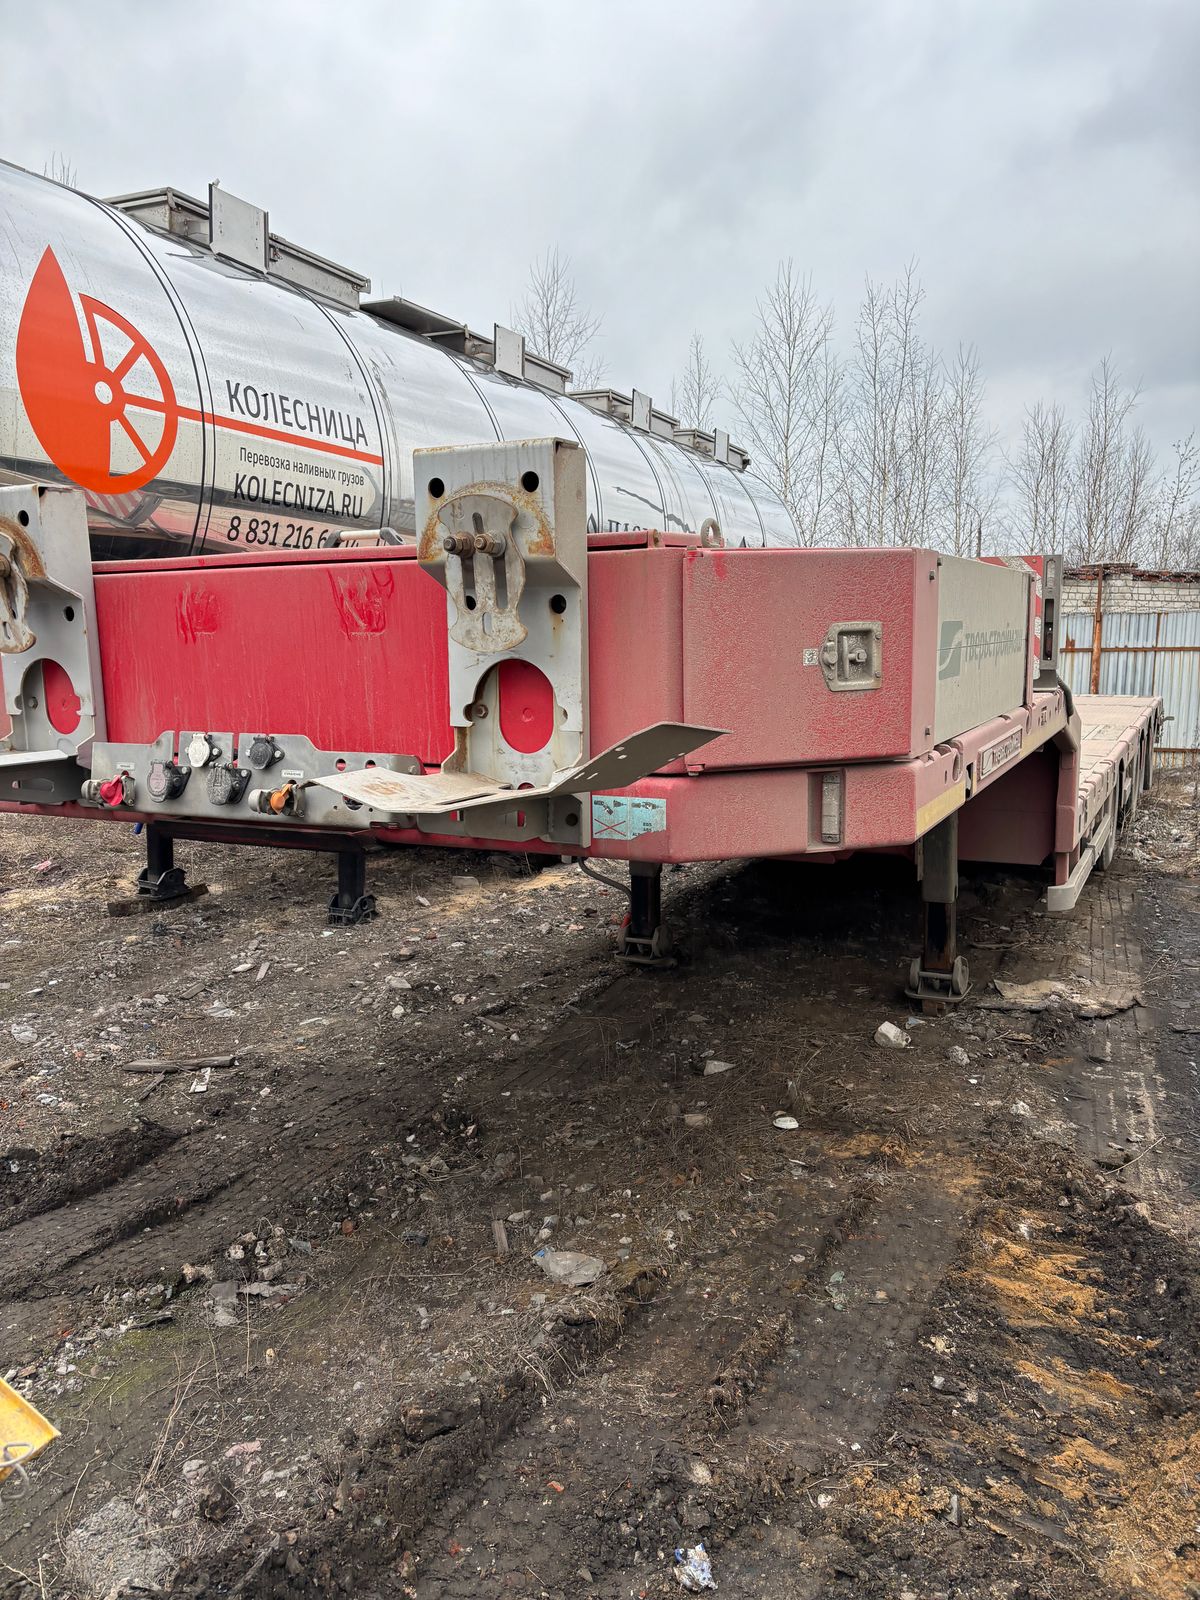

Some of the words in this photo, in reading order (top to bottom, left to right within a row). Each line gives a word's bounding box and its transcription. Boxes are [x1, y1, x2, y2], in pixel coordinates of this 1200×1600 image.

[226, 380, 368, 450] КОЛЕСНИЦА
[240, 447, 290, 470] Перевозка
[293, 460, 336, 481] наливных
[338, 471, 364, 487] грузов
[234, 473, 363, 519] KOLECNIZA.RU
[227, 516, 241, 541] 8
[245, 519, 280, 546] 831
[282, 524, 314, 549] 216
